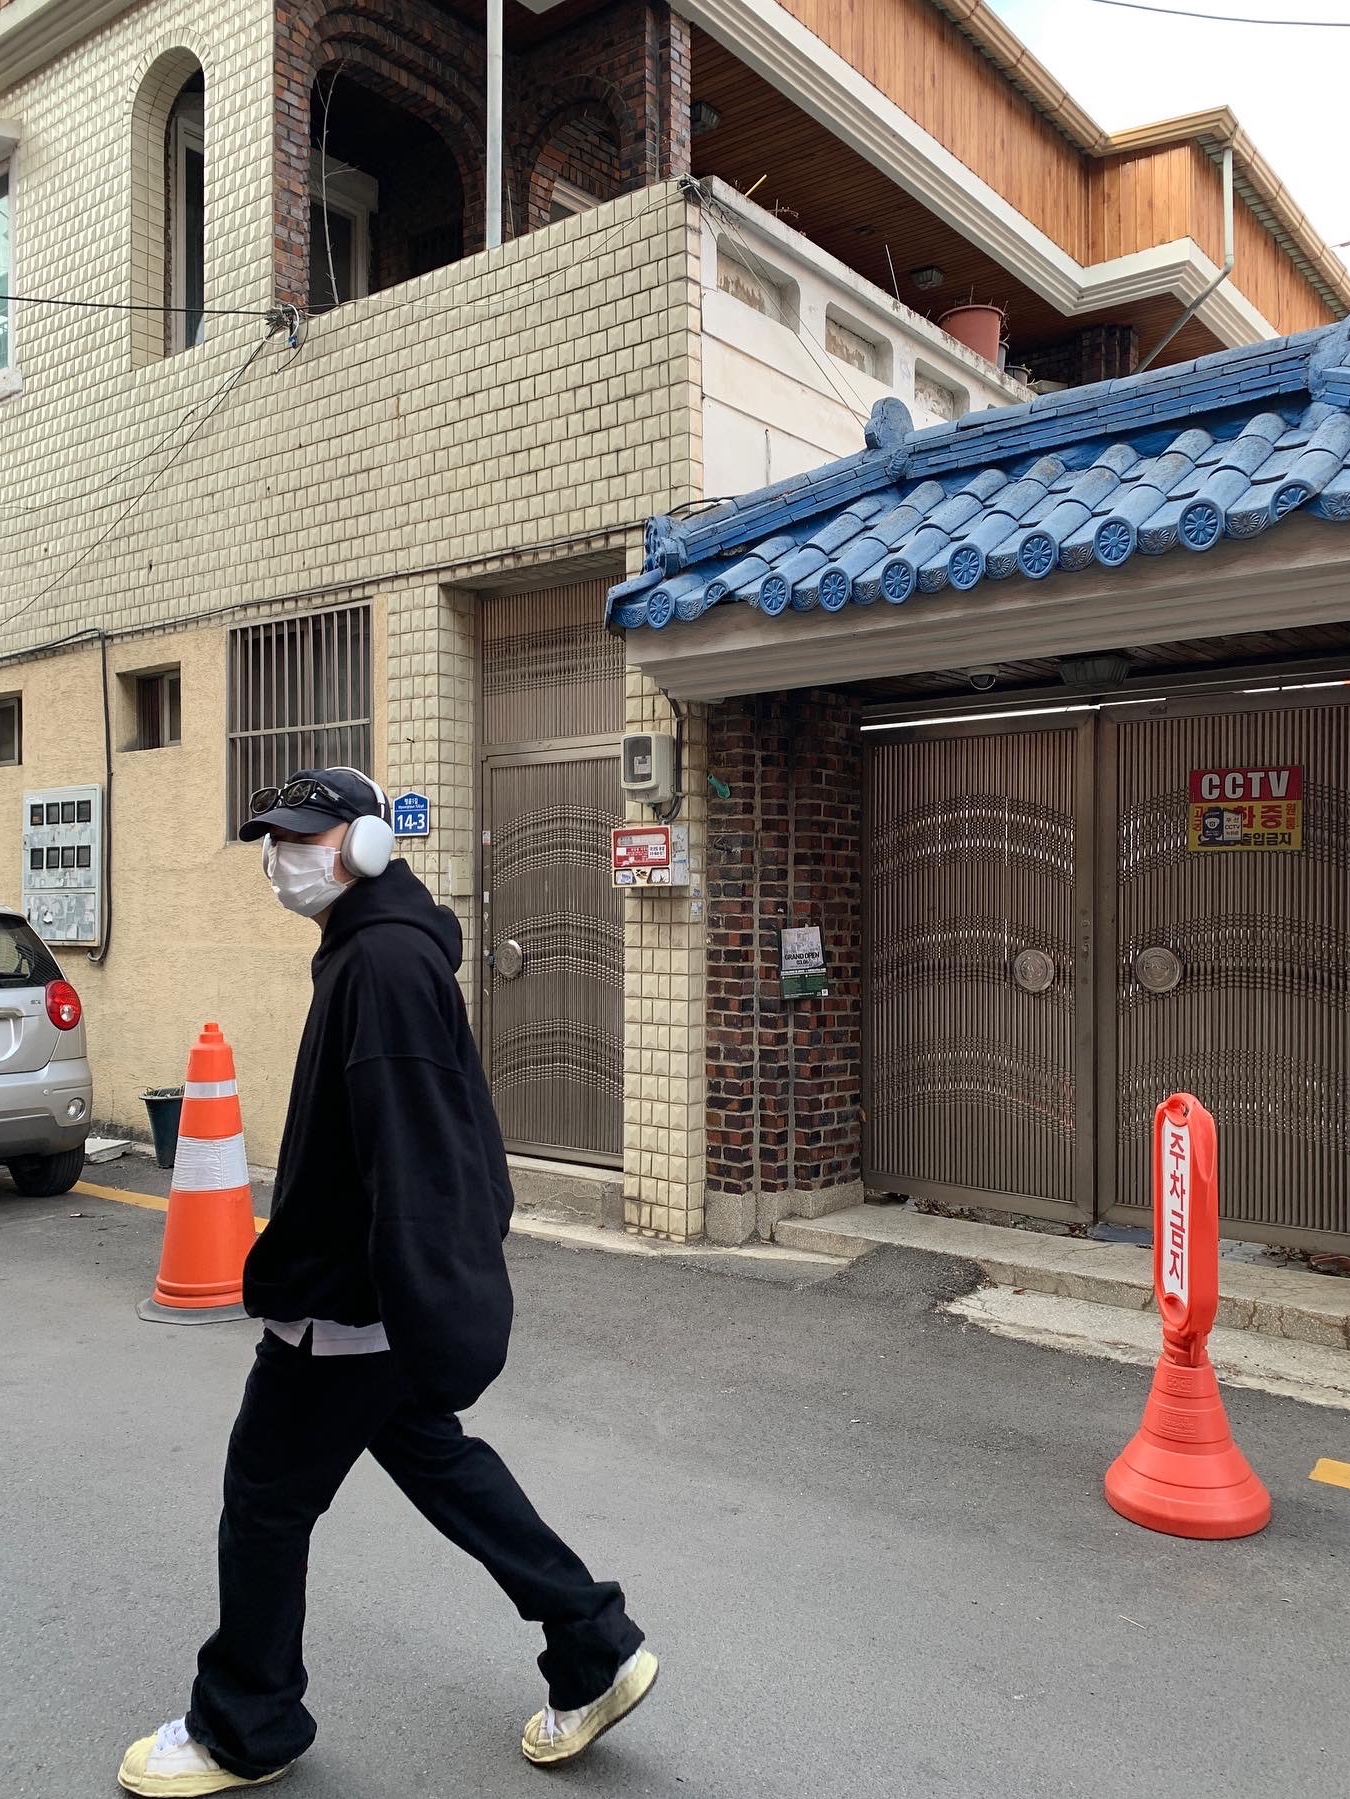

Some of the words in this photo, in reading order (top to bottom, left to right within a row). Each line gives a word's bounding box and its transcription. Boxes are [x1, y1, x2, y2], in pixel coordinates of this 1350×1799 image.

[1201, 771, 1290, 800] CCTV
[397, 813, 425, 830] 14-3
[784, 953, 804, 961] GRAND
[1168, 1131, 1186, 1290] 주차금지
